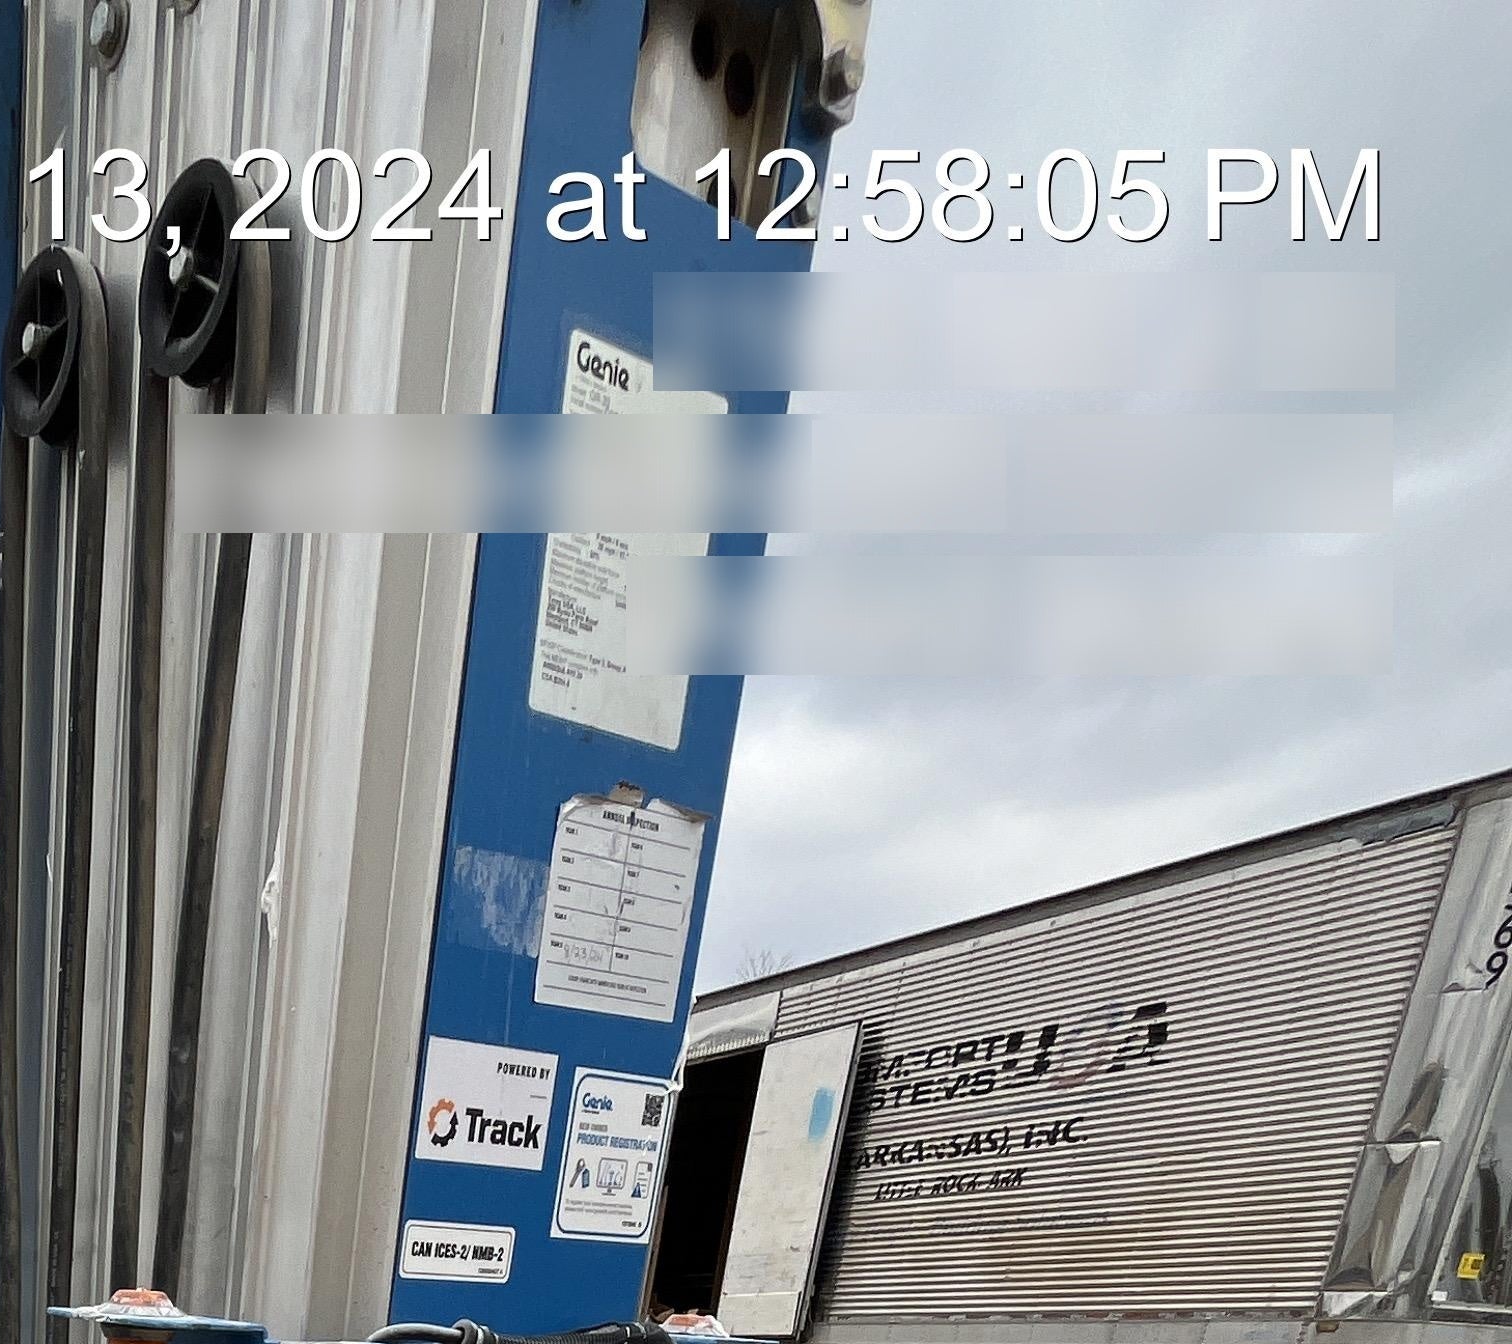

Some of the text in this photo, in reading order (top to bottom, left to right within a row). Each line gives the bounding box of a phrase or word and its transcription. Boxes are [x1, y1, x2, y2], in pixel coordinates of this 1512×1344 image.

[577, 341, 630, 391] Genie
[497, 1062, 550, 1080] POWERED BY
[582, 1092, 613, 1111] Genie
[465, 1107, 542, 1149] Track
[576, 1132, 609, 1147] PRODUCT
[411, 1241, 433, 1257] CAN
[434, 1243, 471, 1261] ICES-2/
